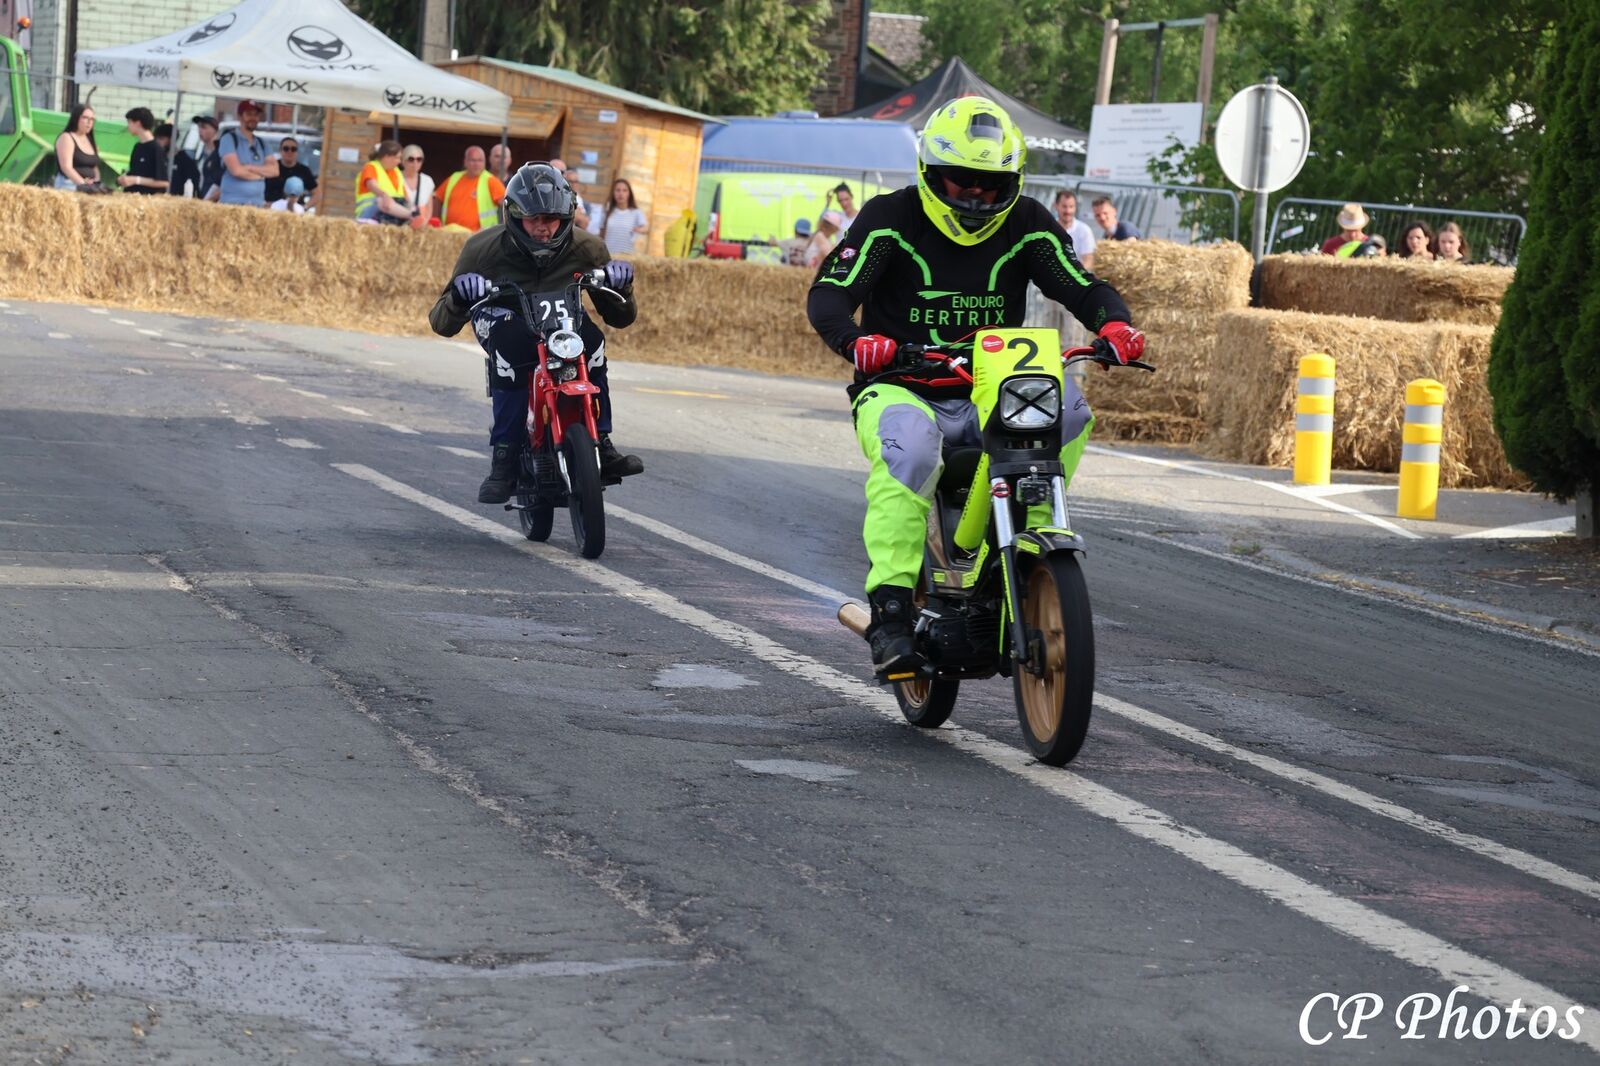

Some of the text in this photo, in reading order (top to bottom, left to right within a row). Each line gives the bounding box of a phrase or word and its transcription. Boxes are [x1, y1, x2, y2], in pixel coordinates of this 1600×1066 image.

[237, 73, 309, 95] 24MX
[407, 93, 478, 114] 24MX
[539, 299, 569, 321] 25
[952, 295, 1005, 309] ENDURO
[909, 307, 1005, 325] BERTRIX
[1007, 337, 1045, 372] 2
